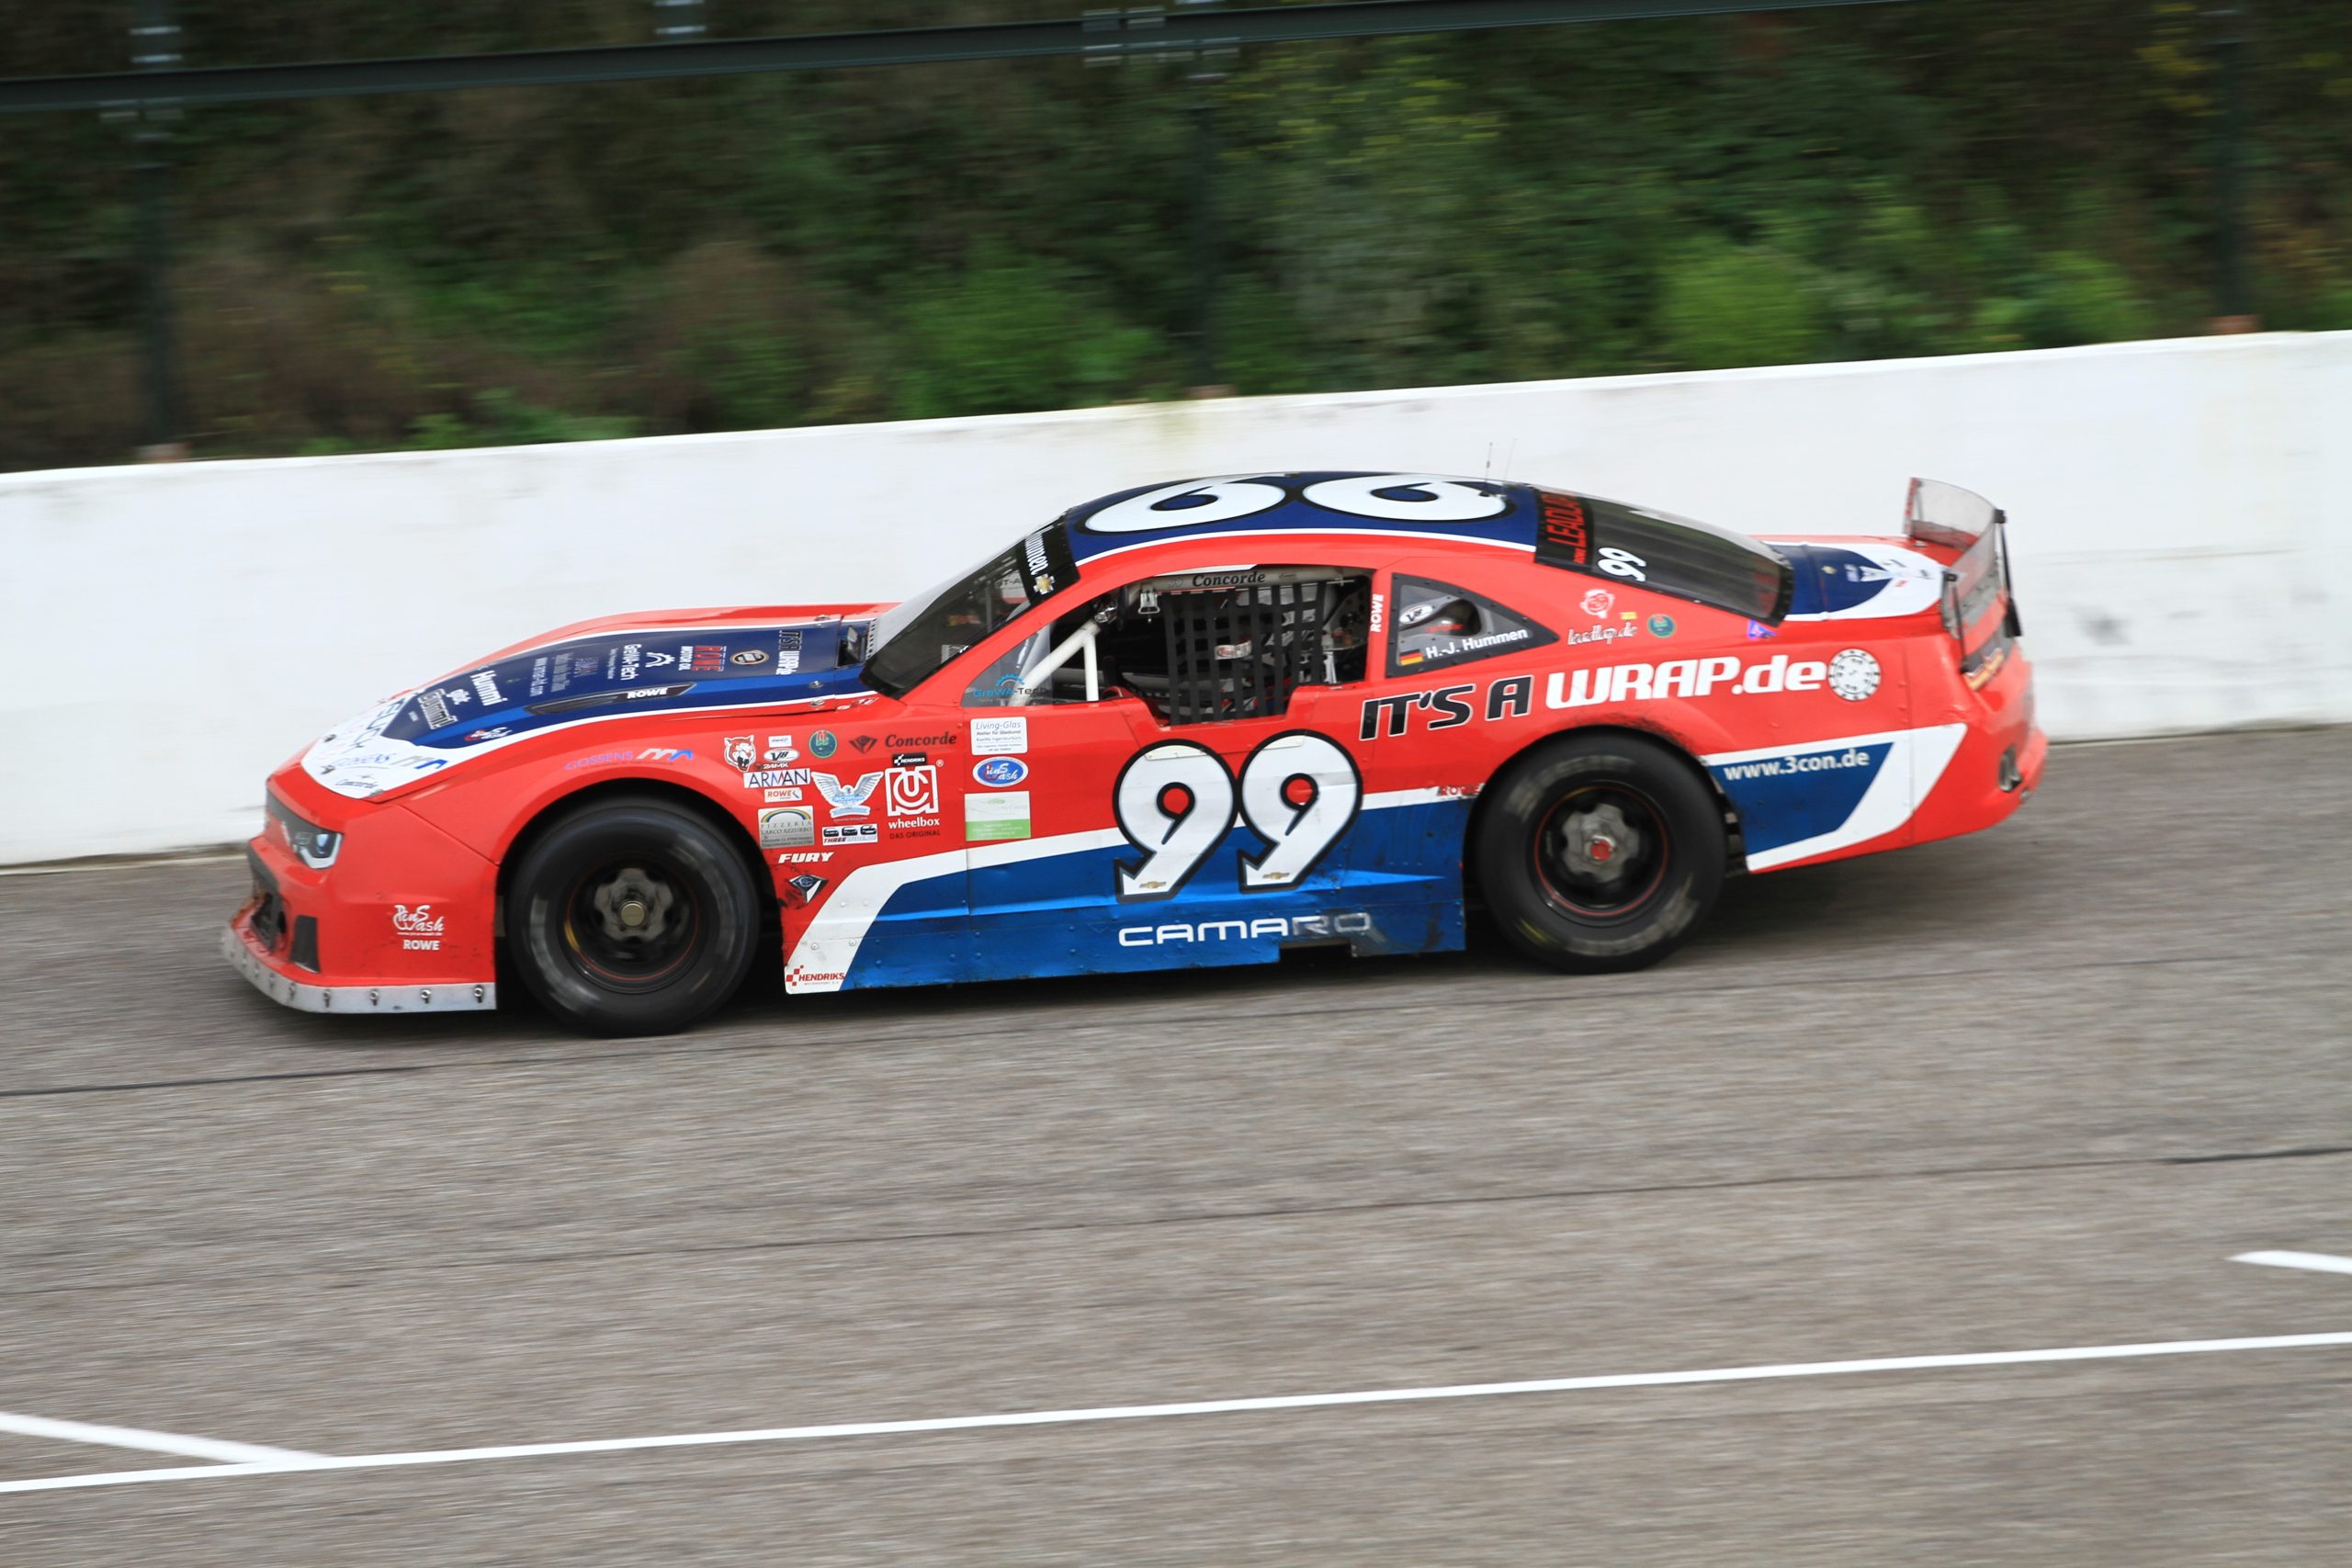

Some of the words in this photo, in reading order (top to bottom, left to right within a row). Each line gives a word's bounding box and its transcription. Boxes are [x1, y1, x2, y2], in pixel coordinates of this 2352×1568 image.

[1598, 547, 1647, 582] 99
[1192, 570, 1266, 588] Concorde
[1371, 593, 1384, 632] ROWE
[1425, 642, 1460, 659] H.-J.
[1462, 628, 1529, 651] Hummen
[470, 670, 508, 706] Hummi
[627, 687, 669, 699] ROWE
[1359, 682, 1476, 741] IT'S
[1485, 674, 1534, 721] A
[1545, 654, 1826, 710] WRAP.de
[976, 720, 1022, 731] Living-Glas
[885, 731, 957, 748] Concorde
[1724, 747, 1871, 782] www.3con.de
[749, 769, 808, 788] ARMAN
[888, 817, 940, 829] wheelbox
[1112, 728, 1363, 904] 99
[778, 852, 834, 863] FURY
[1118, 912, 1372, 947] CAMARO
[402, 939, 441, 951] ROWE
[798, 972, 845, 982] HENDRIKS
